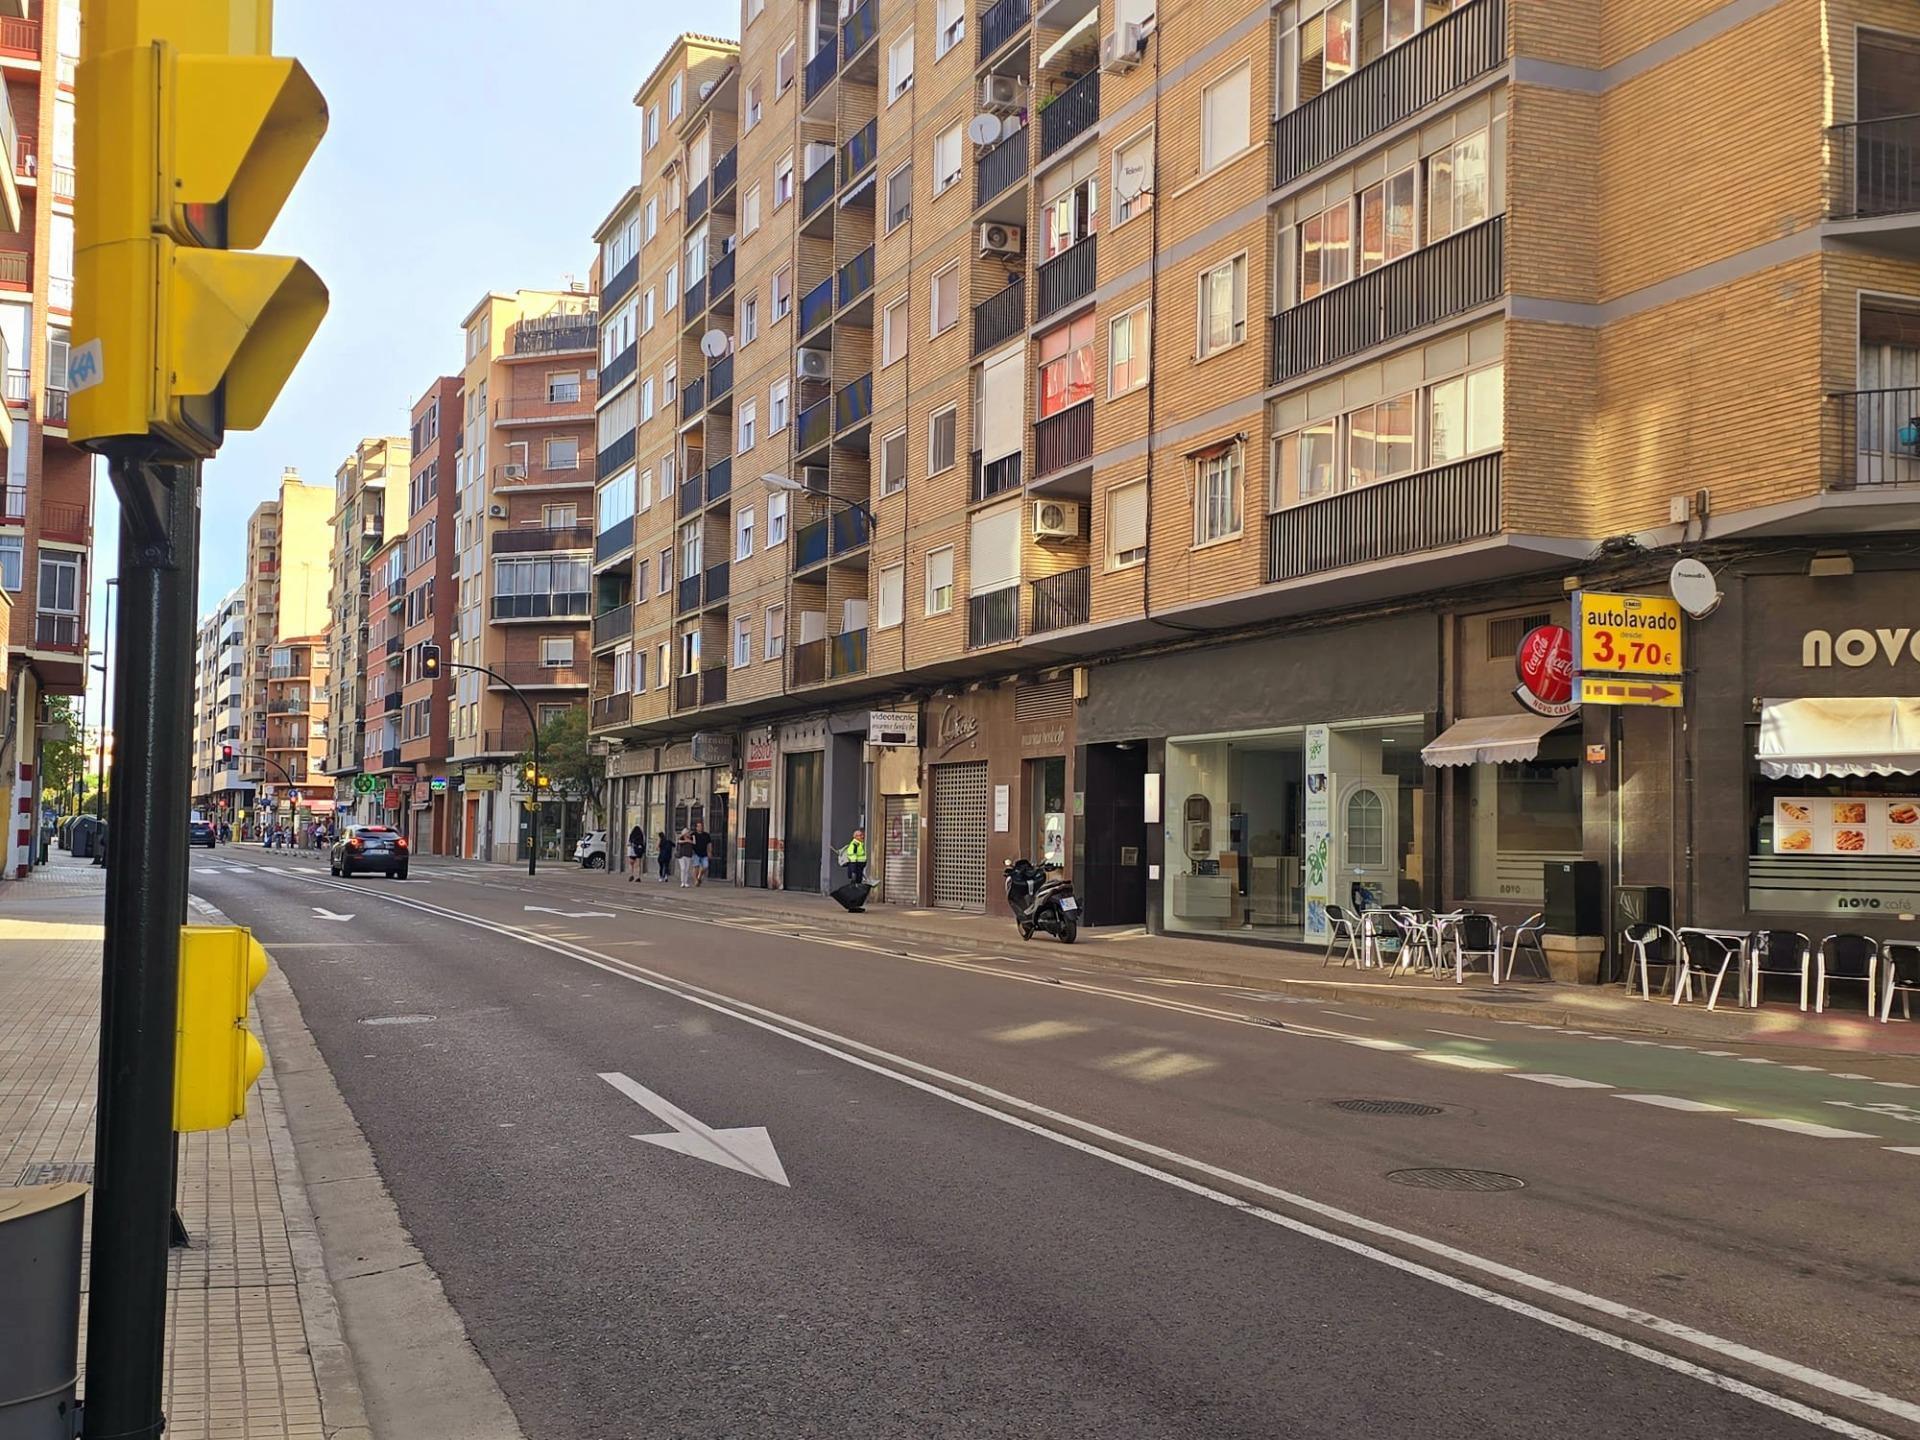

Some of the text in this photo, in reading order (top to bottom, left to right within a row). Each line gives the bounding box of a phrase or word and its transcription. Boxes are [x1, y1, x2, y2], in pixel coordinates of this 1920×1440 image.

[1587, 609, 1677, 630] autolavado
[1802, 628, 1920, 667] nov
[1532, 699, 1553, 713] NOVO
[1838, 897, 1881, 909] novo
